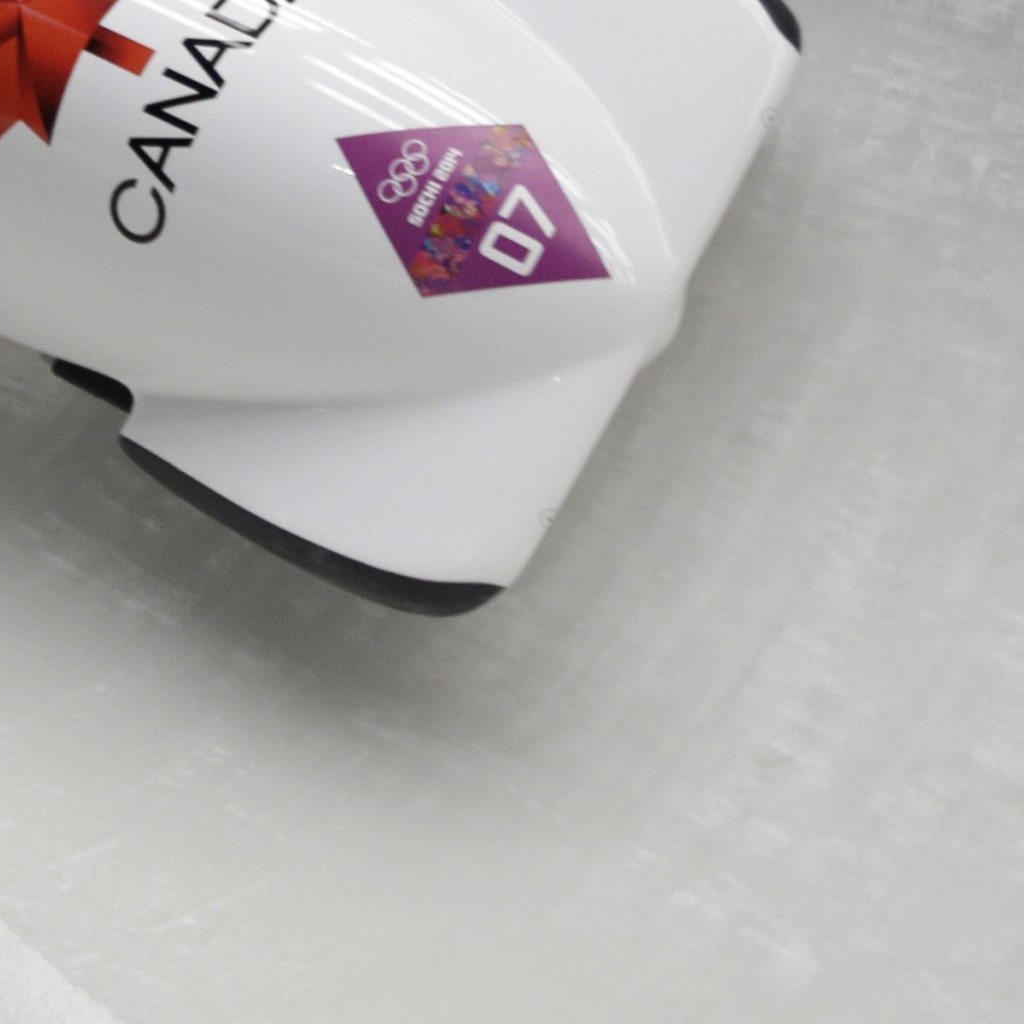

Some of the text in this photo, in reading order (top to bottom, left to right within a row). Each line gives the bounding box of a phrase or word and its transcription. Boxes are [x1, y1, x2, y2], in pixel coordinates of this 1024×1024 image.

[406, 147, 464, 228] SOCHI 2014
[478, 183, 557, 277] 07
